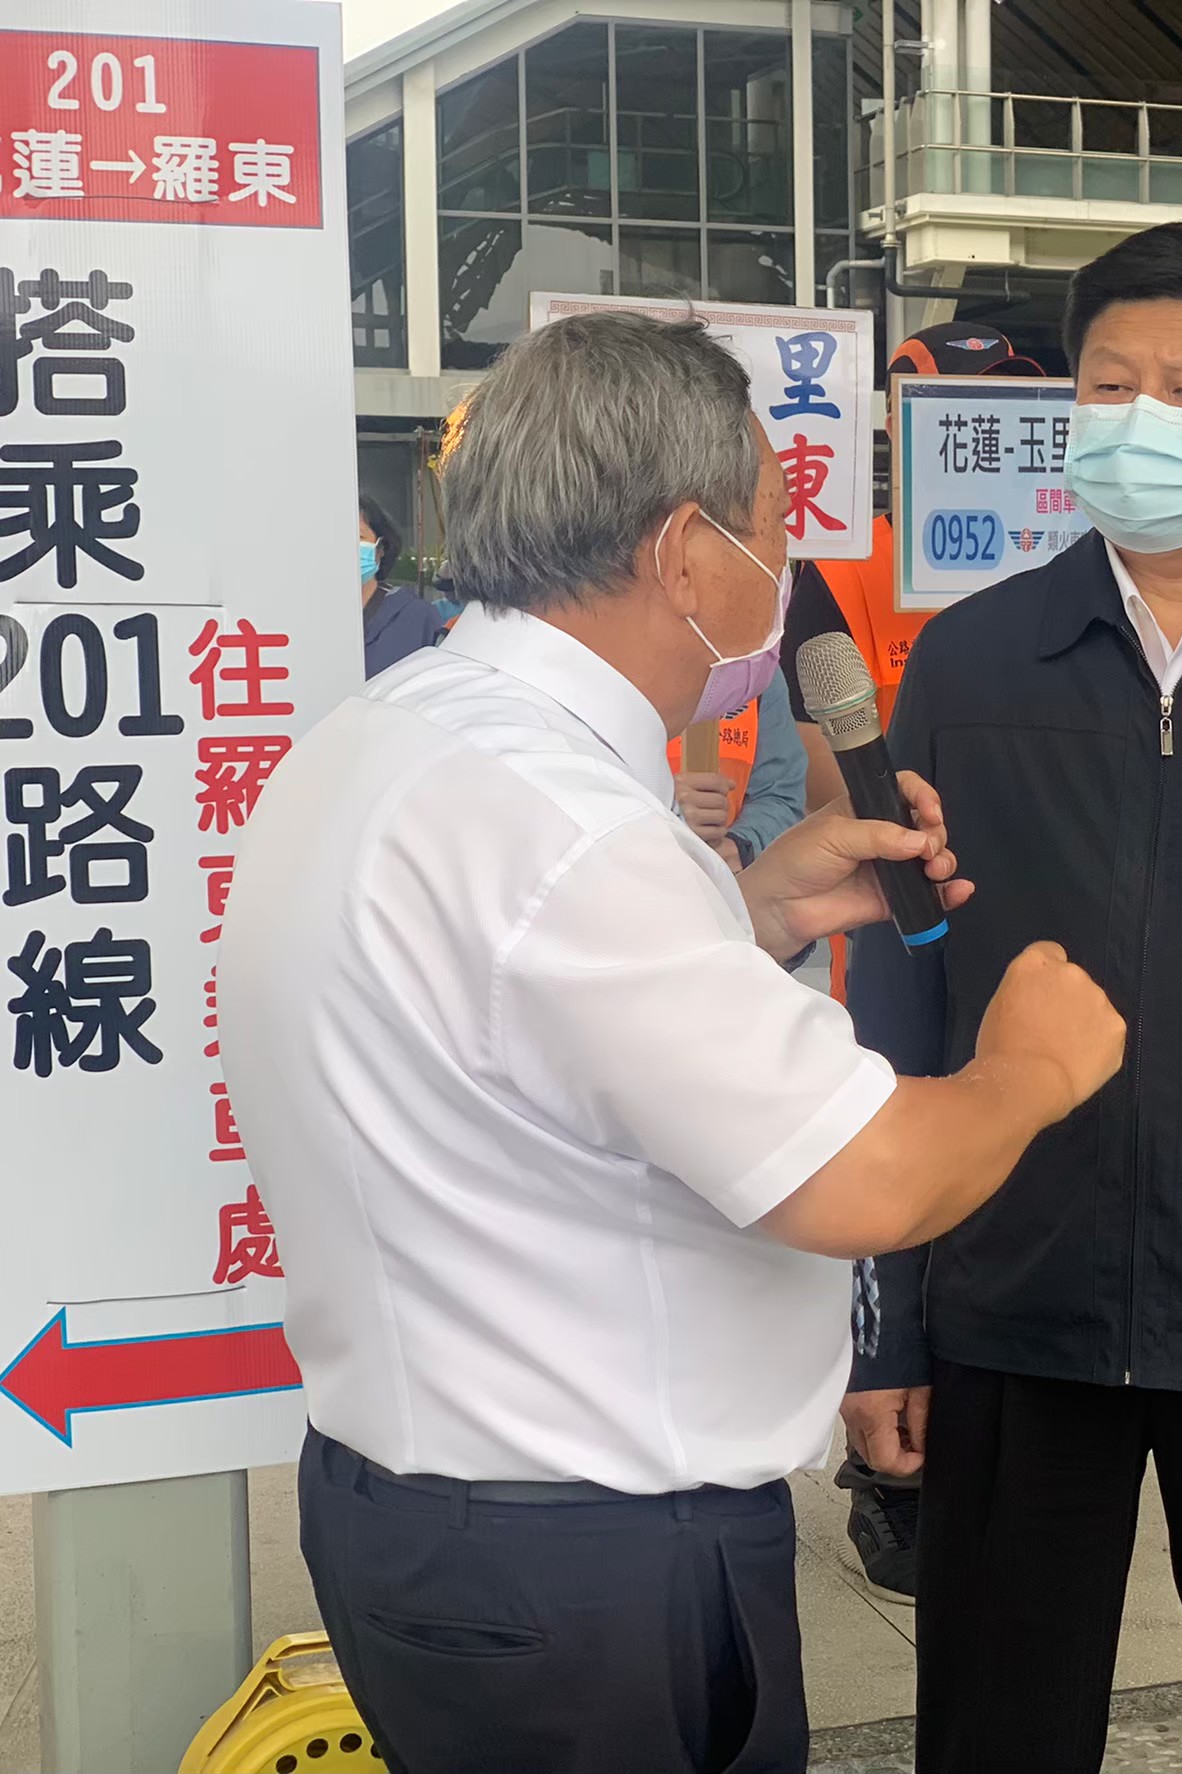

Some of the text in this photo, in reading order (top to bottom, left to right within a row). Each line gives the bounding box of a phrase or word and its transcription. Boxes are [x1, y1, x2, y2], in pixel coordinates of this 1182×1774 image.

[47, 49, 166, 114] 201
[0, 128, 84, 199] 蓮
[931, 514, 996, 561] 0952
[888, 639, 914, 656] 公路
[188, 618, 295, 1285] 往羅處
